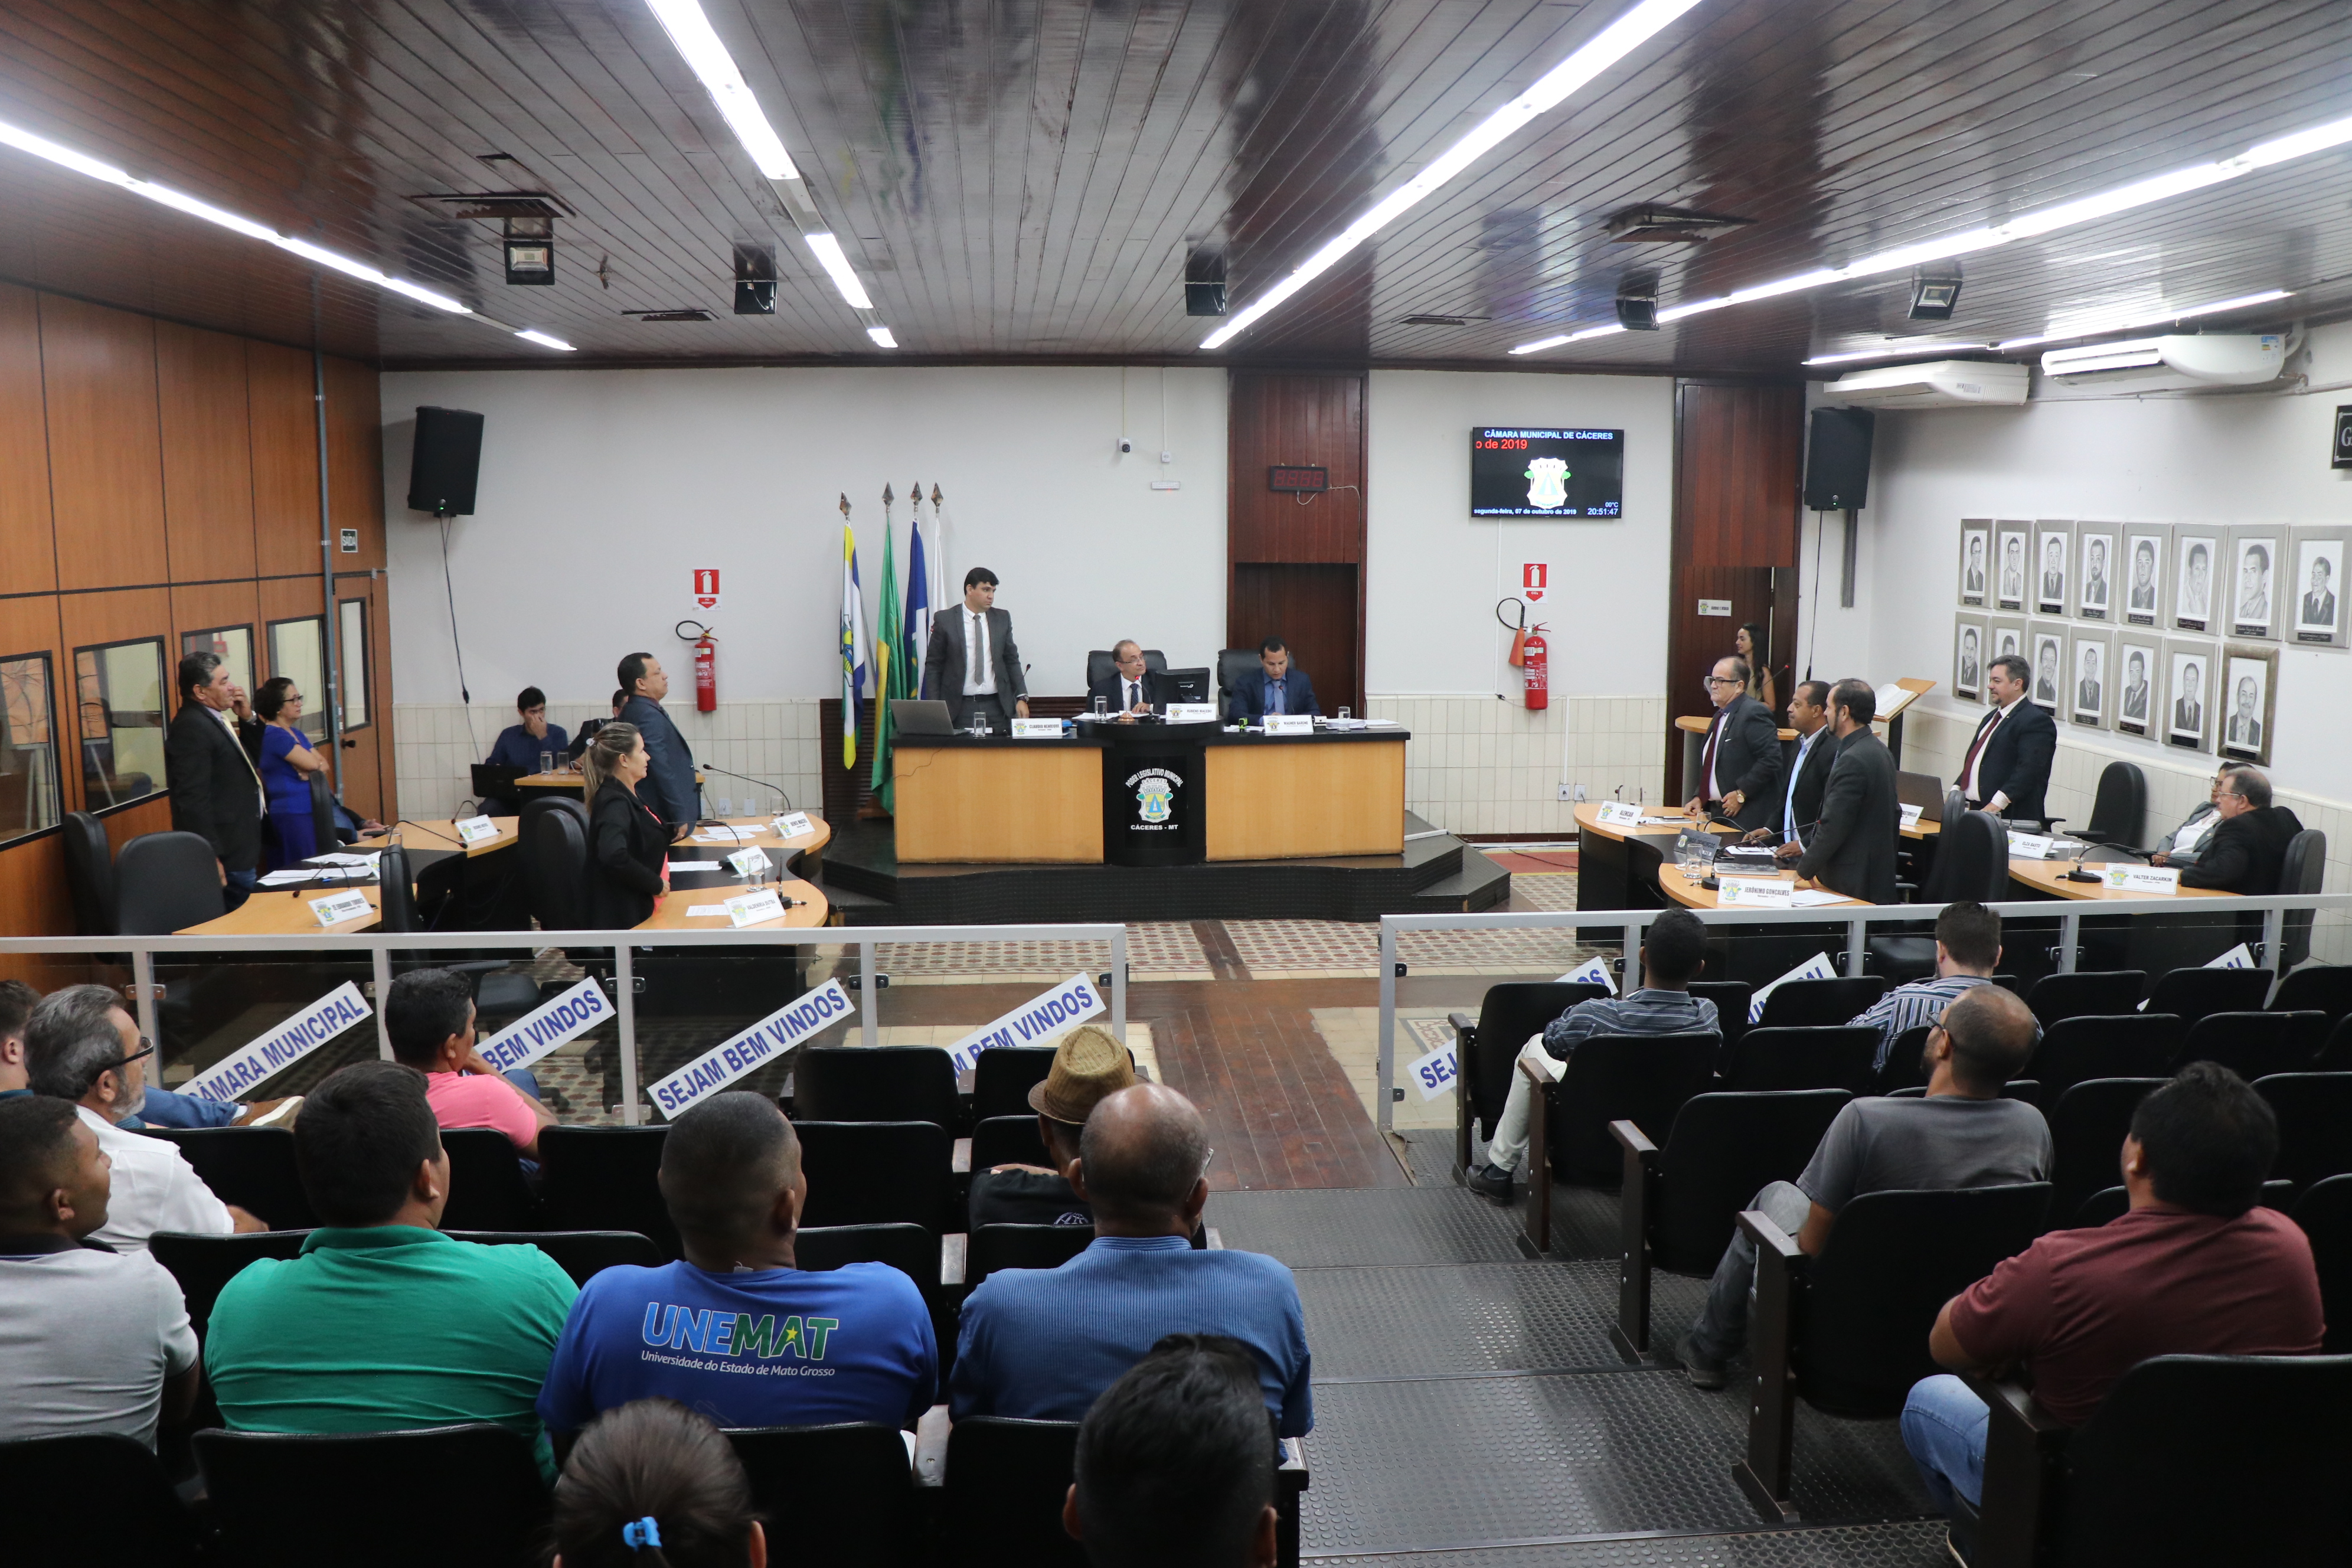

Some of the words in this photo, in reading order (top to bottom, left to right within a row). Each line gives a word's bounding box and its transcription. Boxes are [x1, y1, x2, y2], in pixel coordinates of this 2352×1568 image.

[1484, 429, 1519, 439] CÂMARA
[1520, 430, 1562, 439] MUNICIPAL
[1576, 430, 1613, 440] CÁCERES
[1485, 439, 1498, 449] de
[1501, 439, 1528, 449] 2019
[2341, 427, 2352, 447] G
[1125, 774, 1139, 788] PODER
[1137, 768, 1165, 779] LEGISLATIVO
[1164, 769, 1184, 788] MUNICIPAL
[1744, 886, 1766, 894] JERÔNIMO
[1012, 985, 1093, 1041] VINDOS
[262, 995, 364, 1068] MUNICIPAL
[482, 1033, 530, 1072] BEM
[524, 989, 602, 1046] VINDOS
[658, 1057, 726, 1110] SEJAM
[723, 1031, 771, 1072] BEM
[766, 988, 845, 1045] VINDOS
[642, 1301, 839, 1361] UNEMAT
[641, 1350, 704, 1370] Universidade
[704, 1361, 718, 1371] do
[720, 1361, 754, 1374] Estado
[756, 1364, 769, 1375] de
[771, 1365, 798, 1376] Mato
[800, 1366, 835, 1377] Grosso
